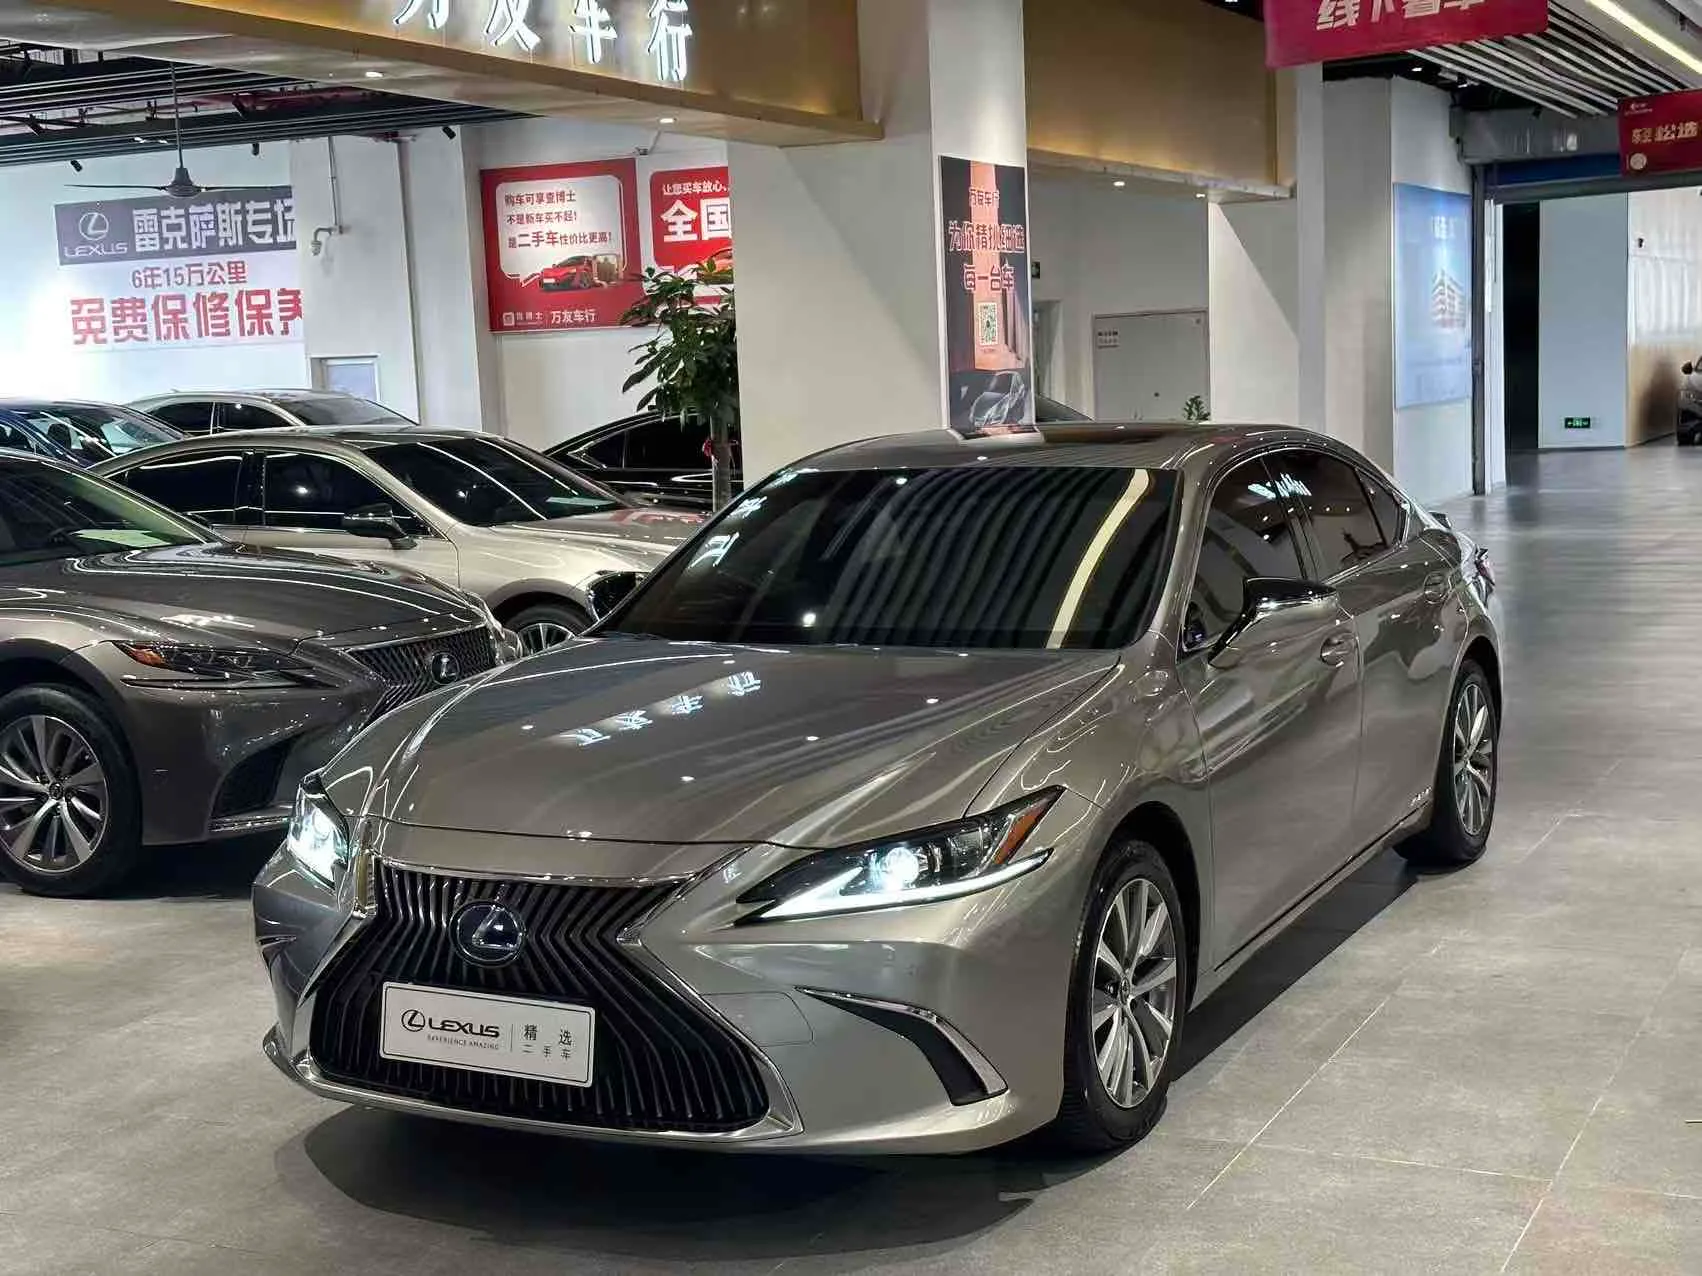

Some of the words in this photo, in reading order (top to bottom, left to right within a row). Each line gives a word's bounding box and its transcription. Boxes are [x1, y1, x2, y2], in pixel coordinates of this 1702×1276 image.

[949, 221, 1024, 252] 为你精挑细选
[64, 242, 128, 257] LEXUS
[132, 260, 247, 289] 6年15万公里
[963, 262, 1014, 291] 每一台车
[551, 308, 596, 324] 万友车行
[428, 1018, 500, 1038] LEXUS
[523, 1024, 572, 1046] 精选
[469, 1040, 499, 1051] AMAZING
[522, 1043, 571, 1061] 二手车
